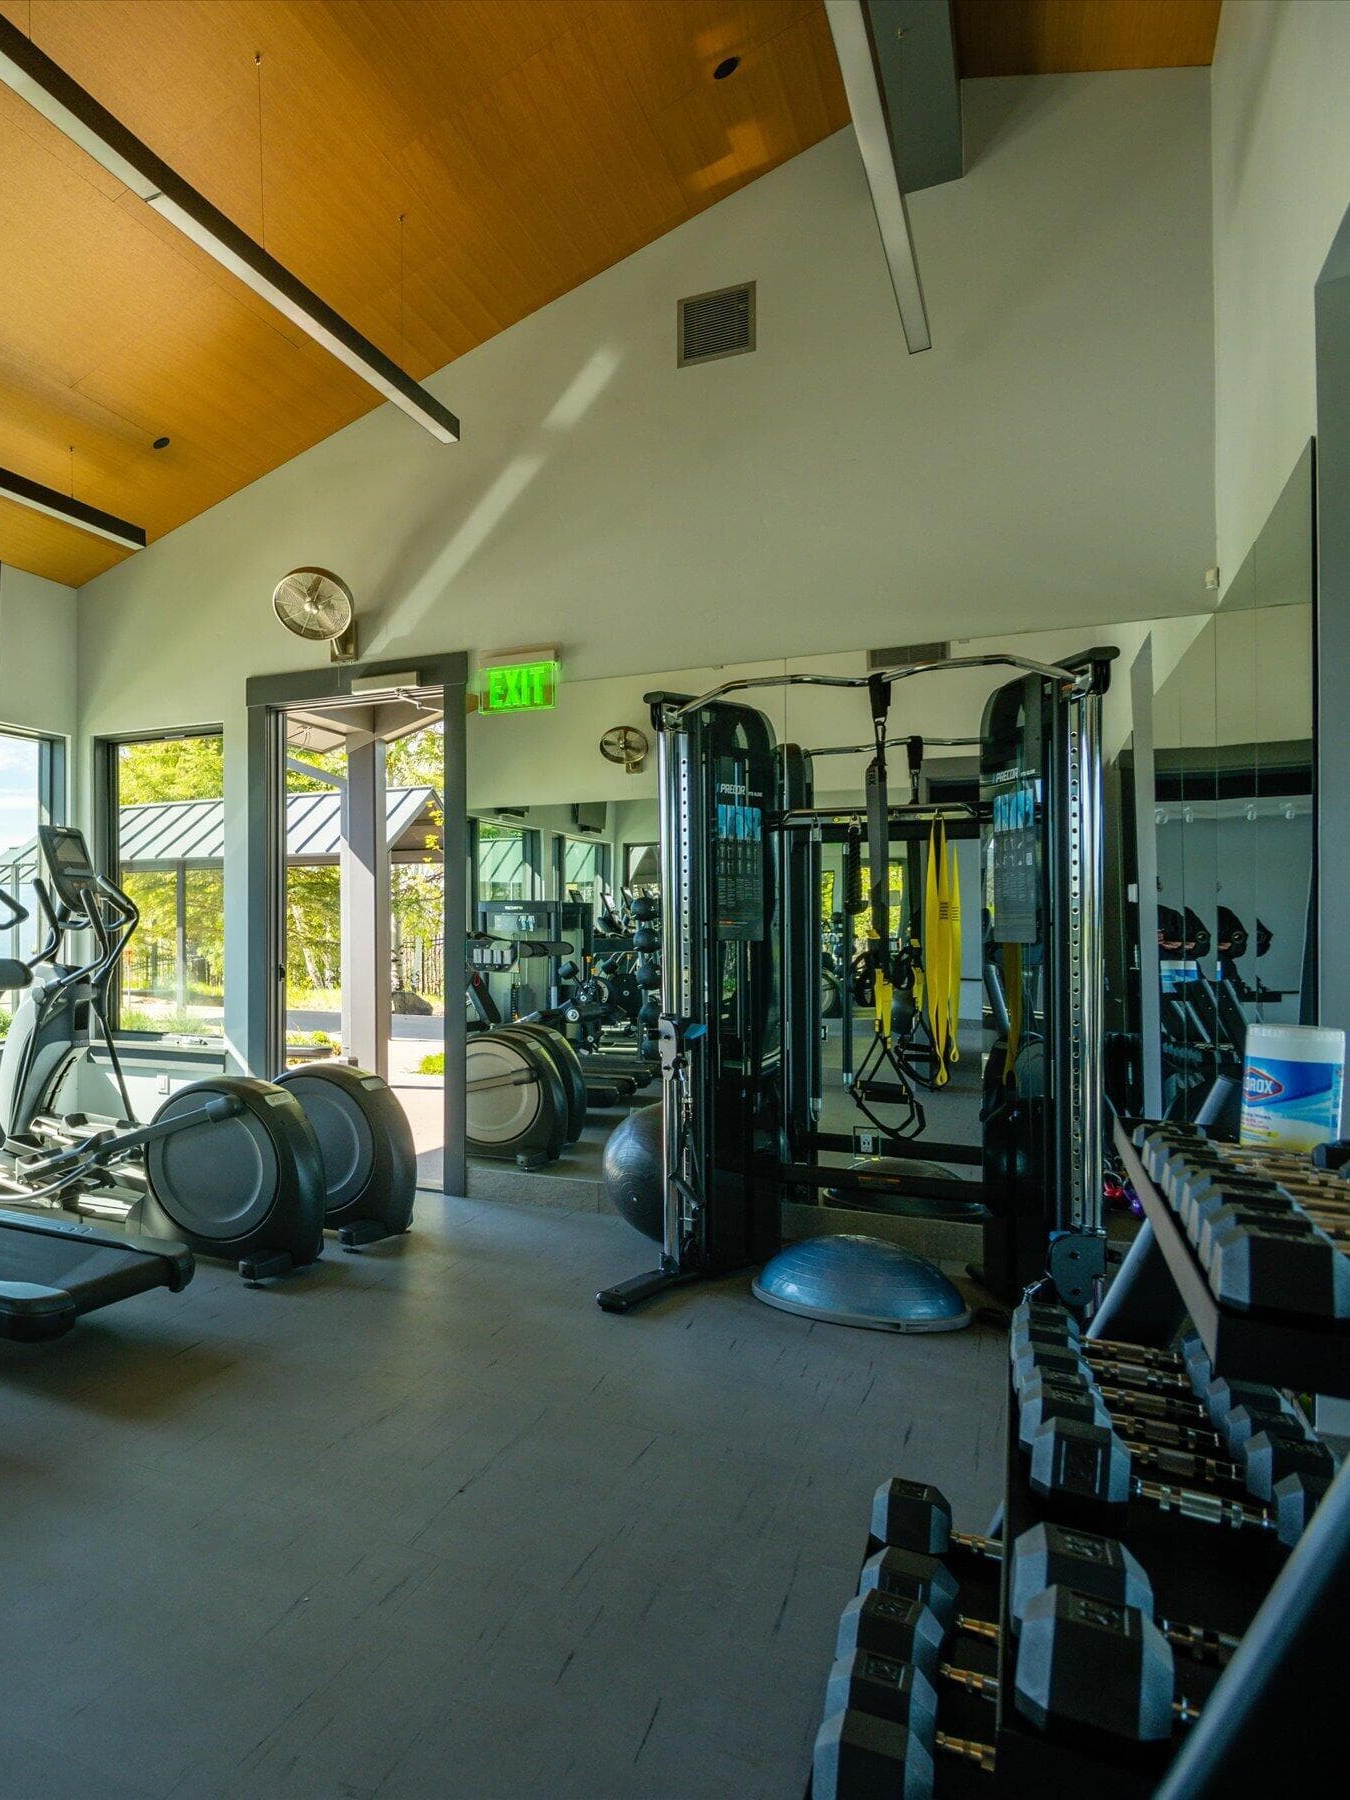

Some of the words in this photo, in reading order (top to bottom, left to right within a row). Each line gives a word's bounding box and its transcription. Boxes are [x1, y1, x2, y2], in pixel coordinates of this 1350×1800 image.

[489, 666, 545, 707] EXIT
[995, 767, 1019, 784] PRECOR
[720, 783, 746, 795] PRECOR
